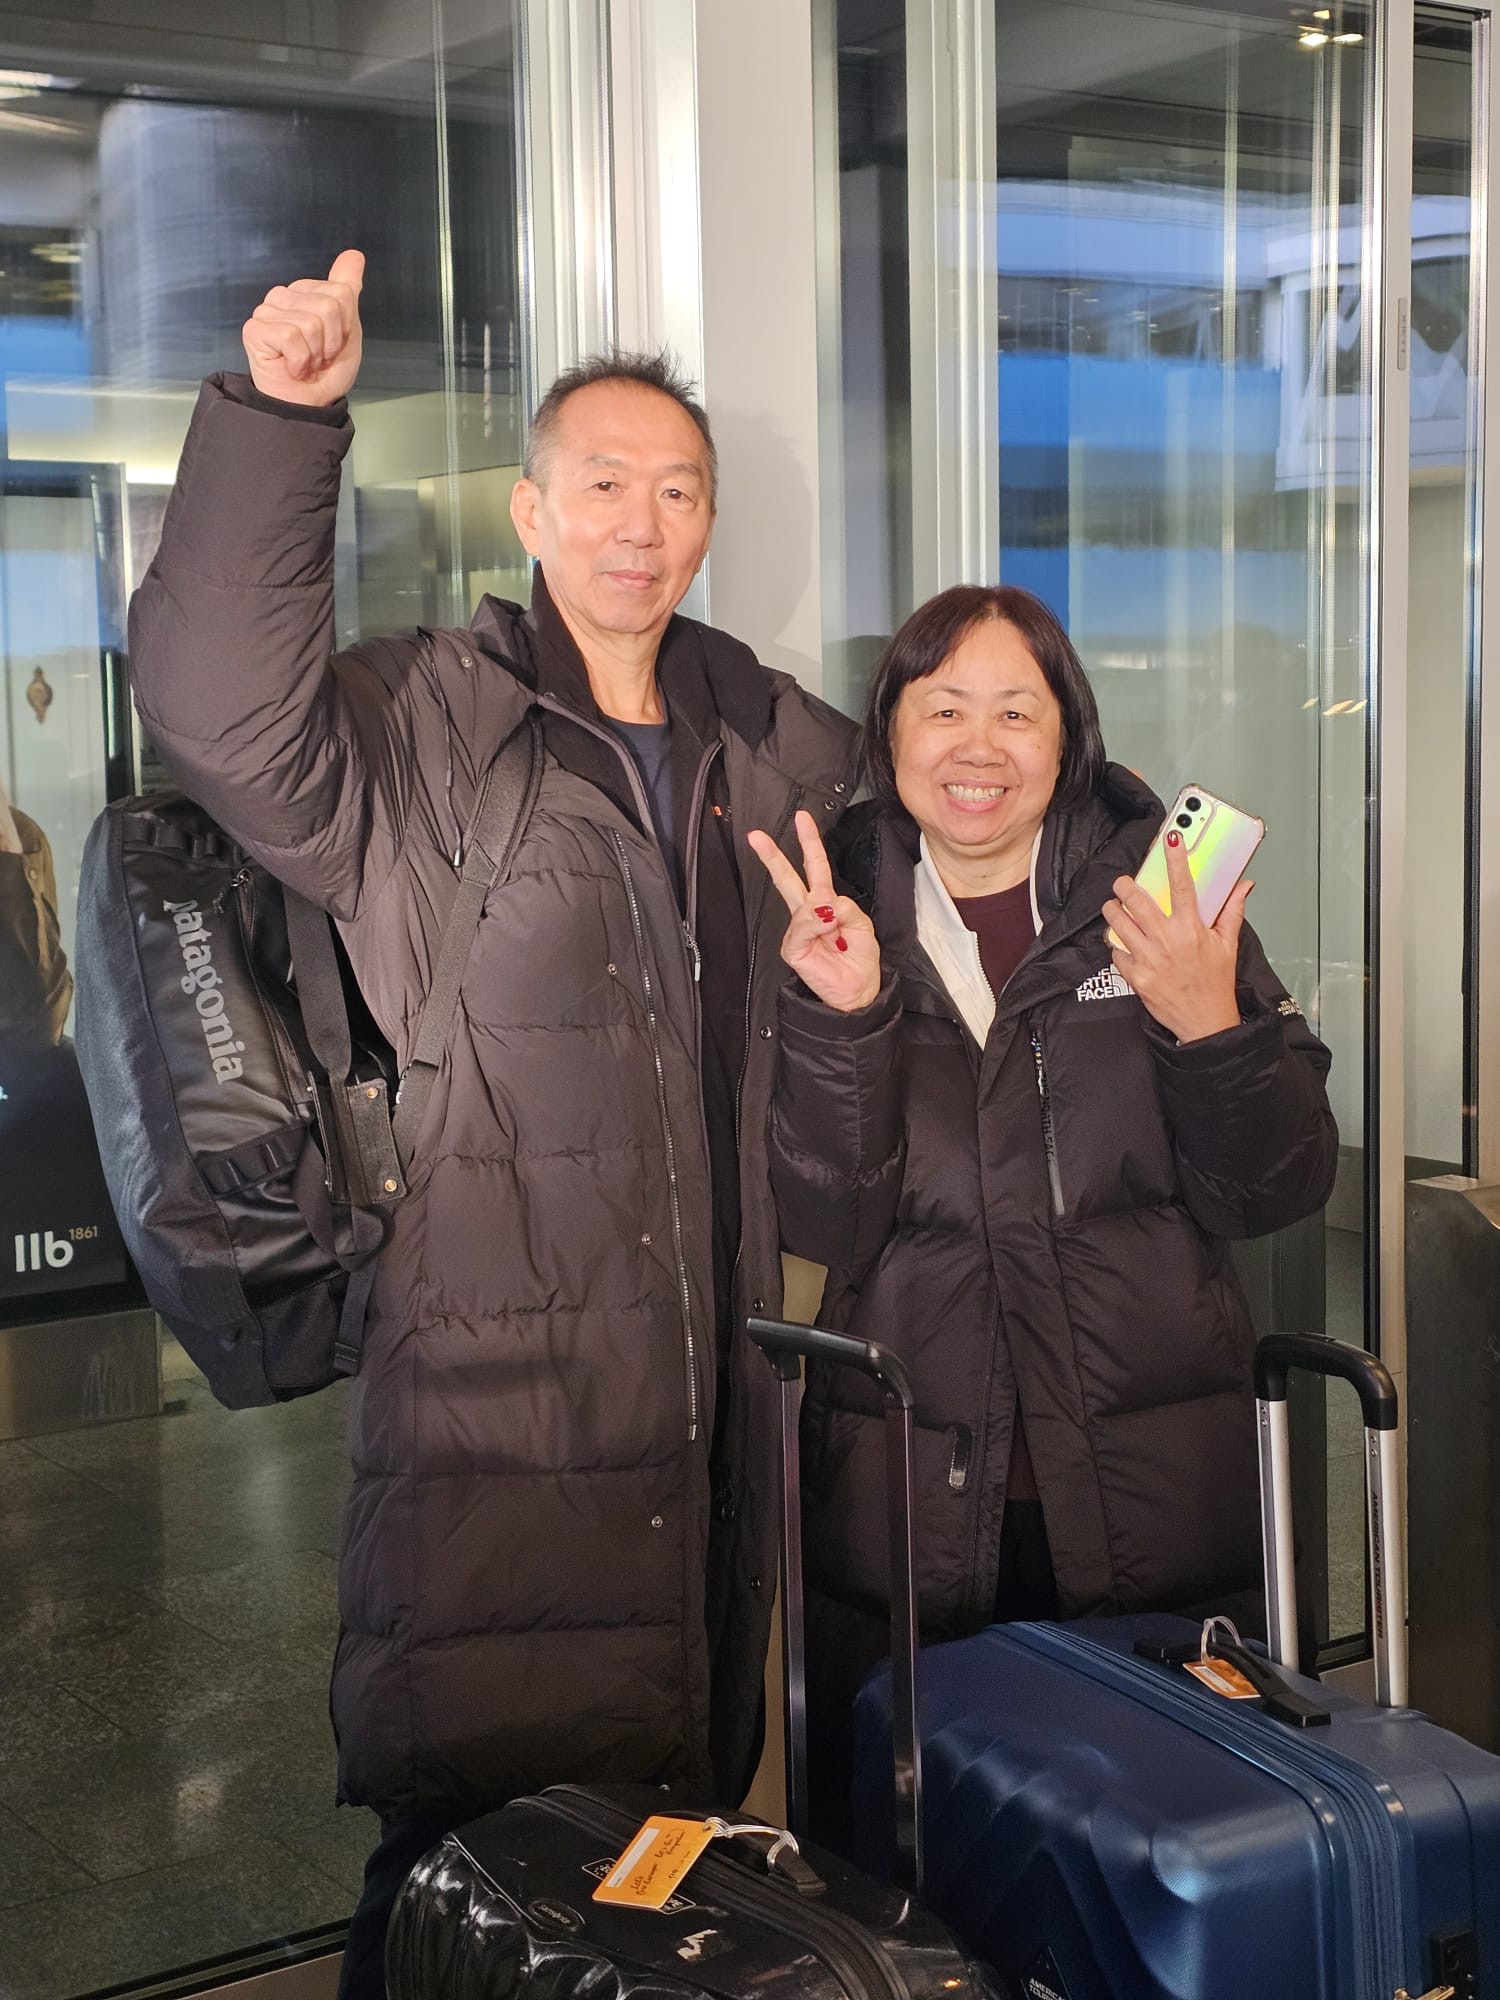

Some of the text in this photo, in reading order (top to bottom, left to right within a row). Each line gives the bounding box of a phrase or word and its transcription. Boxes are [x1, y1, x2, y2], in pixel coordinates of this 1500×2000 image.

[1075, 974, 1112, 990] RTH
[163, 900, 246, 1085] patagonia
[1077, 986, 1114, 1002] FACE
[68, 1226, 98, 1240] 1861
[1371, 1491, 1384, 1640] AMERICAN TOURISTER
